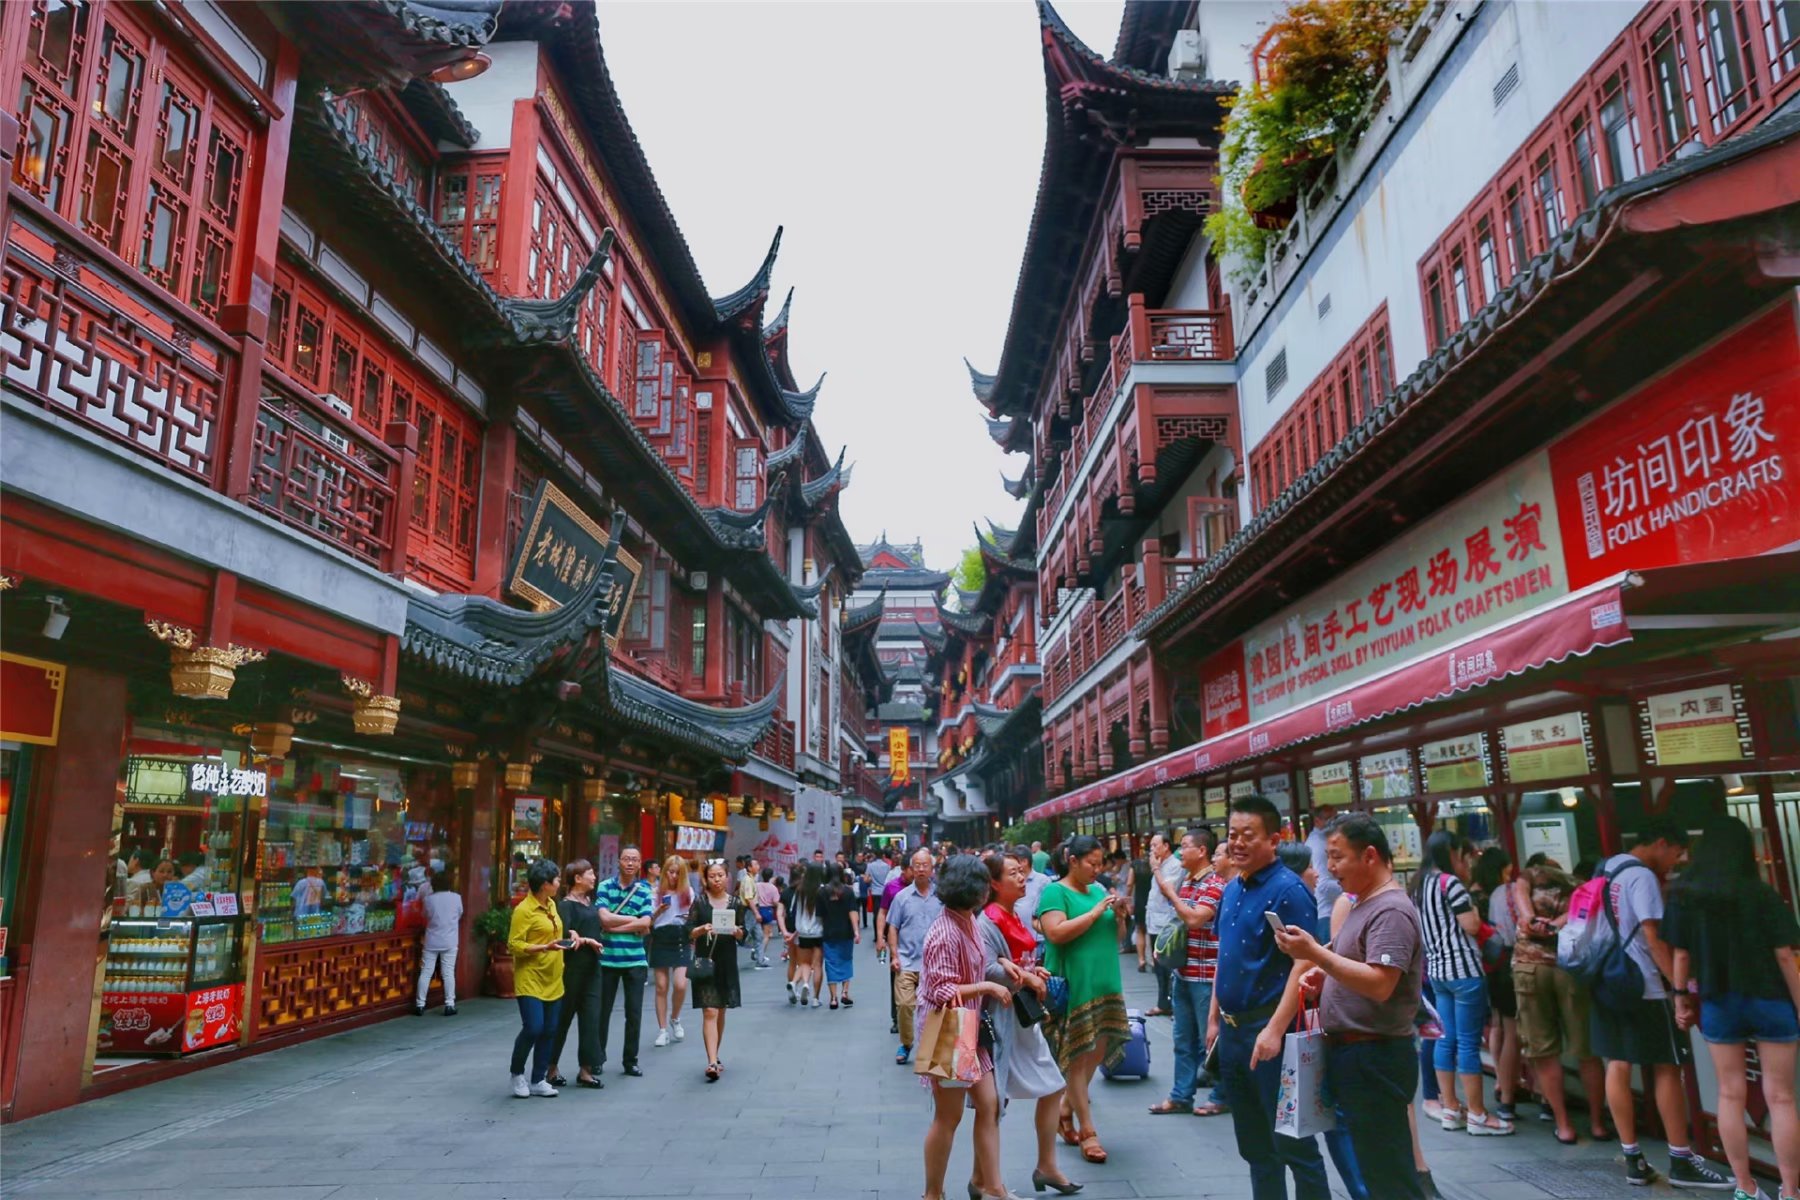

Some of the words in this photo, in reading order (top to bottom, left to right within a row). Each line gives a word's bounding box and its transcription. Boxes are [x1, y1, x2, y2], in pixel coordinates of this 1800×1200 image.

[1601, 391, 1776, 517] 坊间印象
[1606, 515, 1648, 550] FOLK
[1650, 455, 1784, 532] HANDICRAFTS
[1250, 502, 1546, 688] 豫园民间手工艺现场展演
[1298, 661, 1330, 689] SPECIAL
[1331, 651, 1354, 675] SKILL
[1355, 643, 1368, 666] BY
[1370, 624, 1415, 659] YUYUAN
[1417, 606, 1452, 640] FOLK
[1454, 563, 1553, 625] CRAFTSMEN
